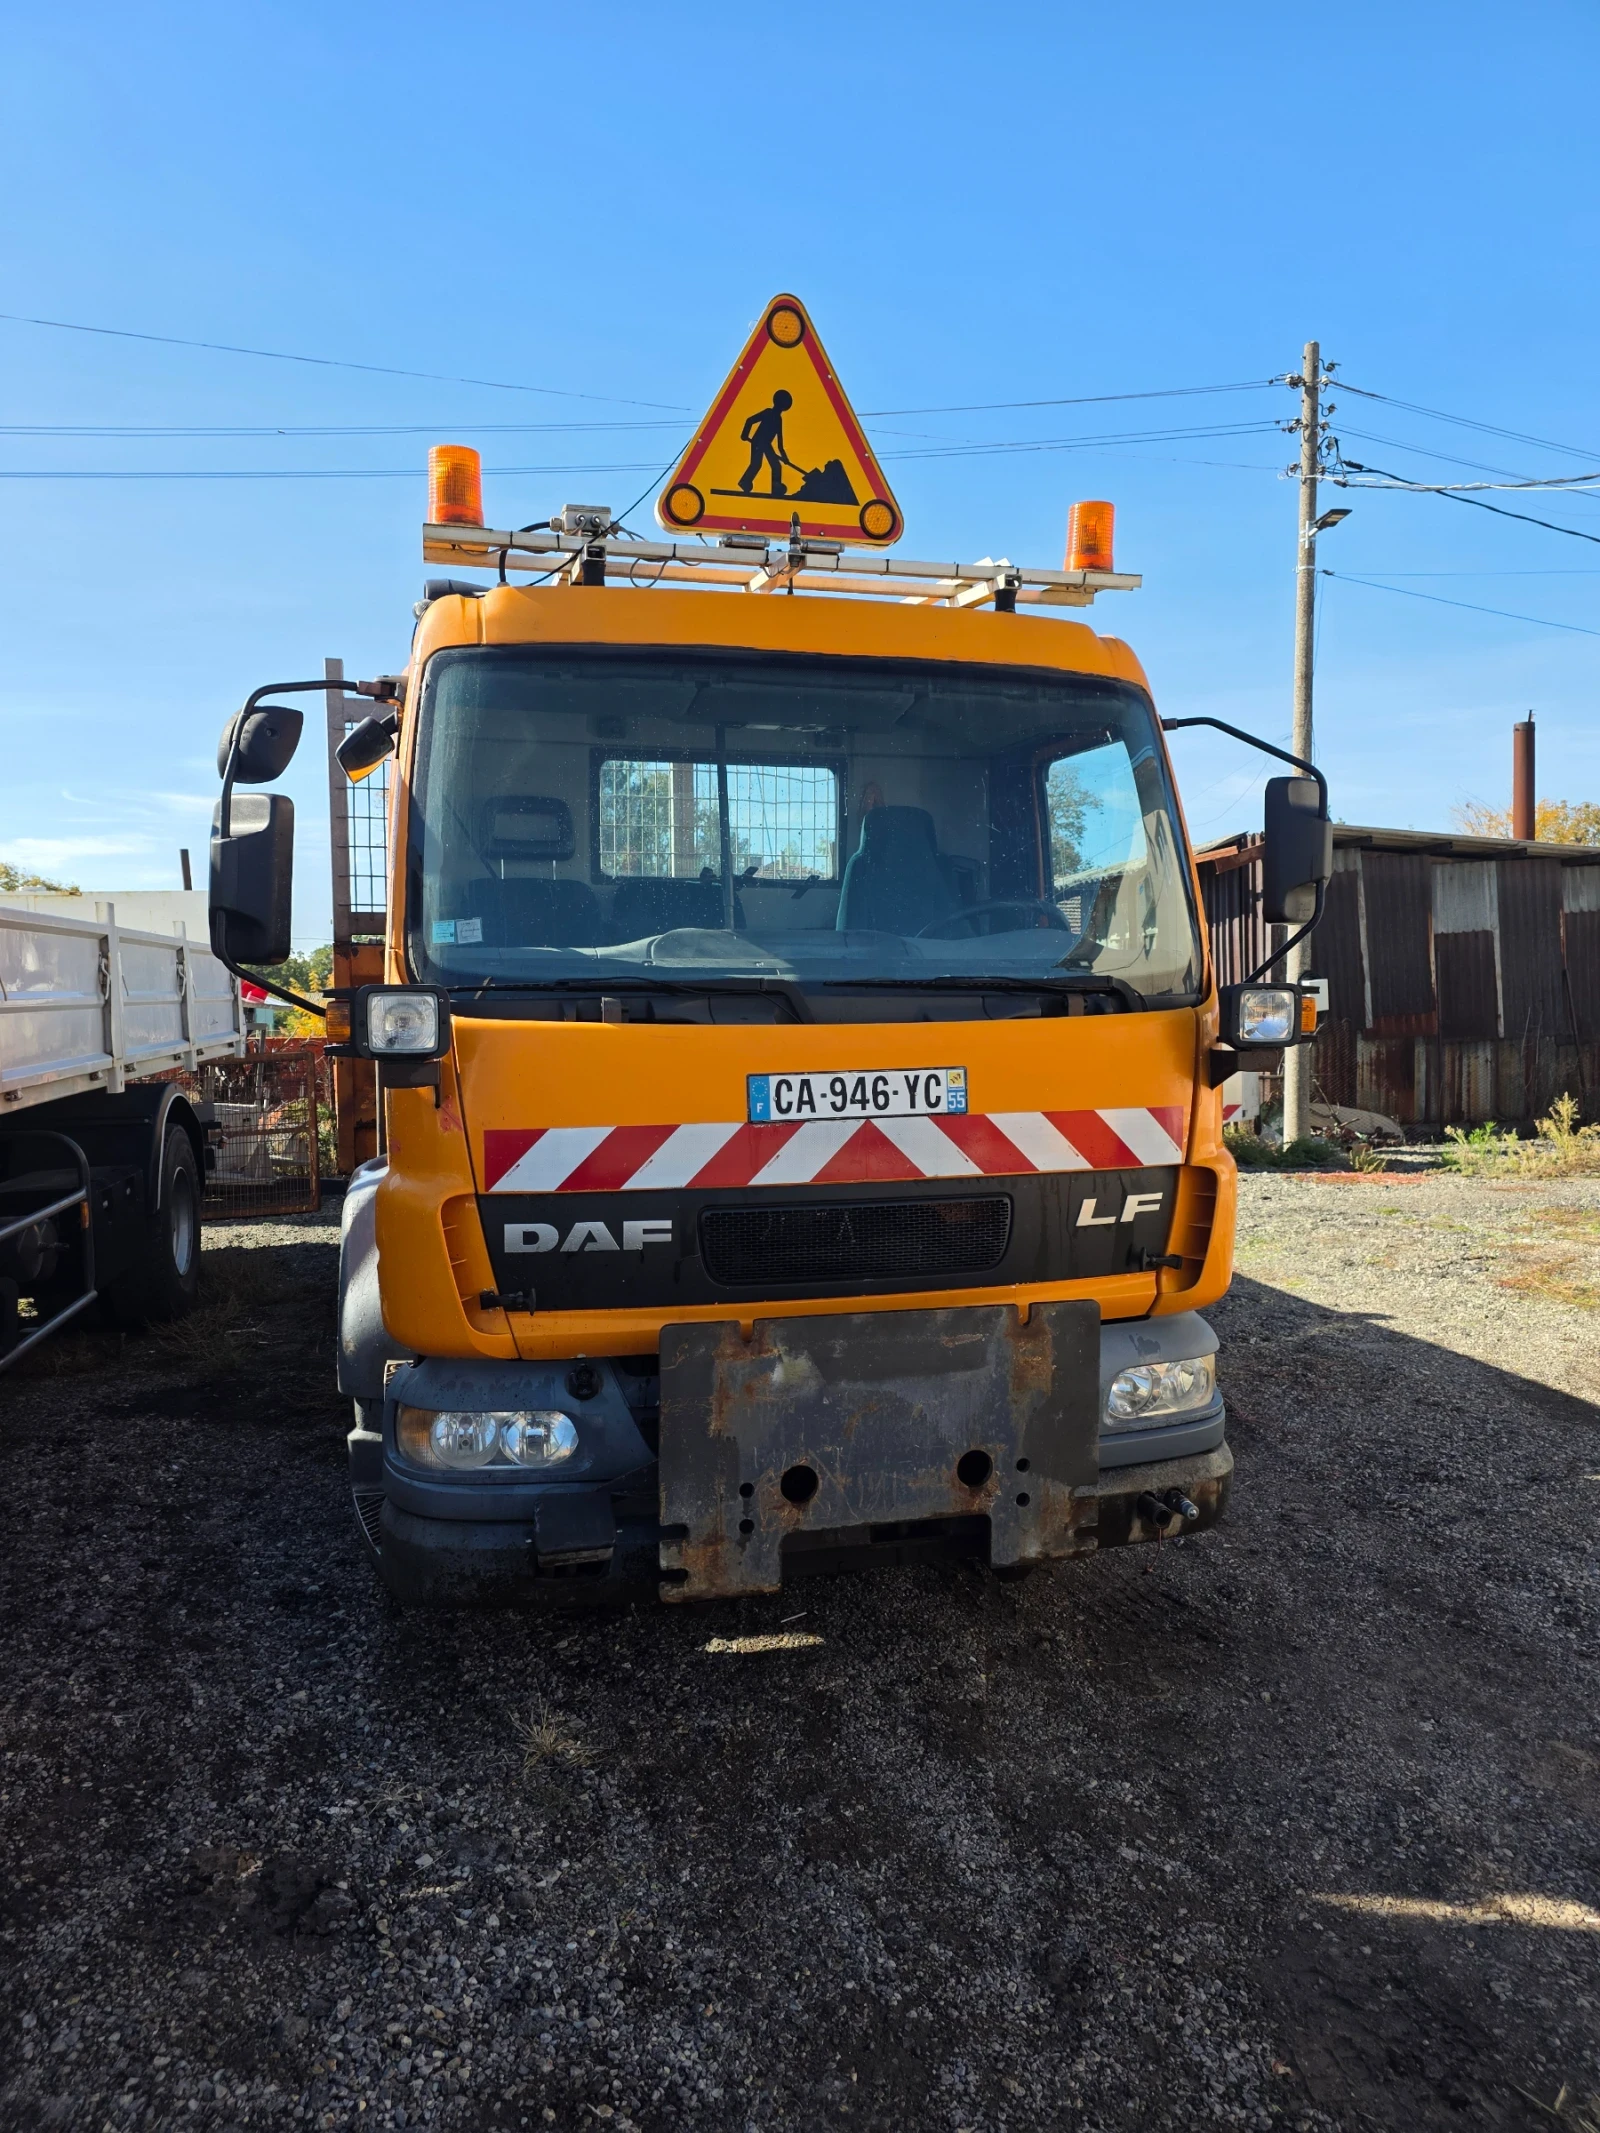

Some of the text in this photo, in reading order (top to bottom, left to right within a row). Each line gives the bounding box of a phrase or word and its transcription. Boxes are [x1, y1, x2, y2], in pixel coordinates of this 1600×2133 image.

[756, 1103, 764, 1114] F
[774, 1073, 942, 1115] CA-946-YC
[948, 1091, 965, 1109] 55
[1076, 1192, 1163, 1227] LF
[504, 1220, 672, 1253] DAF
